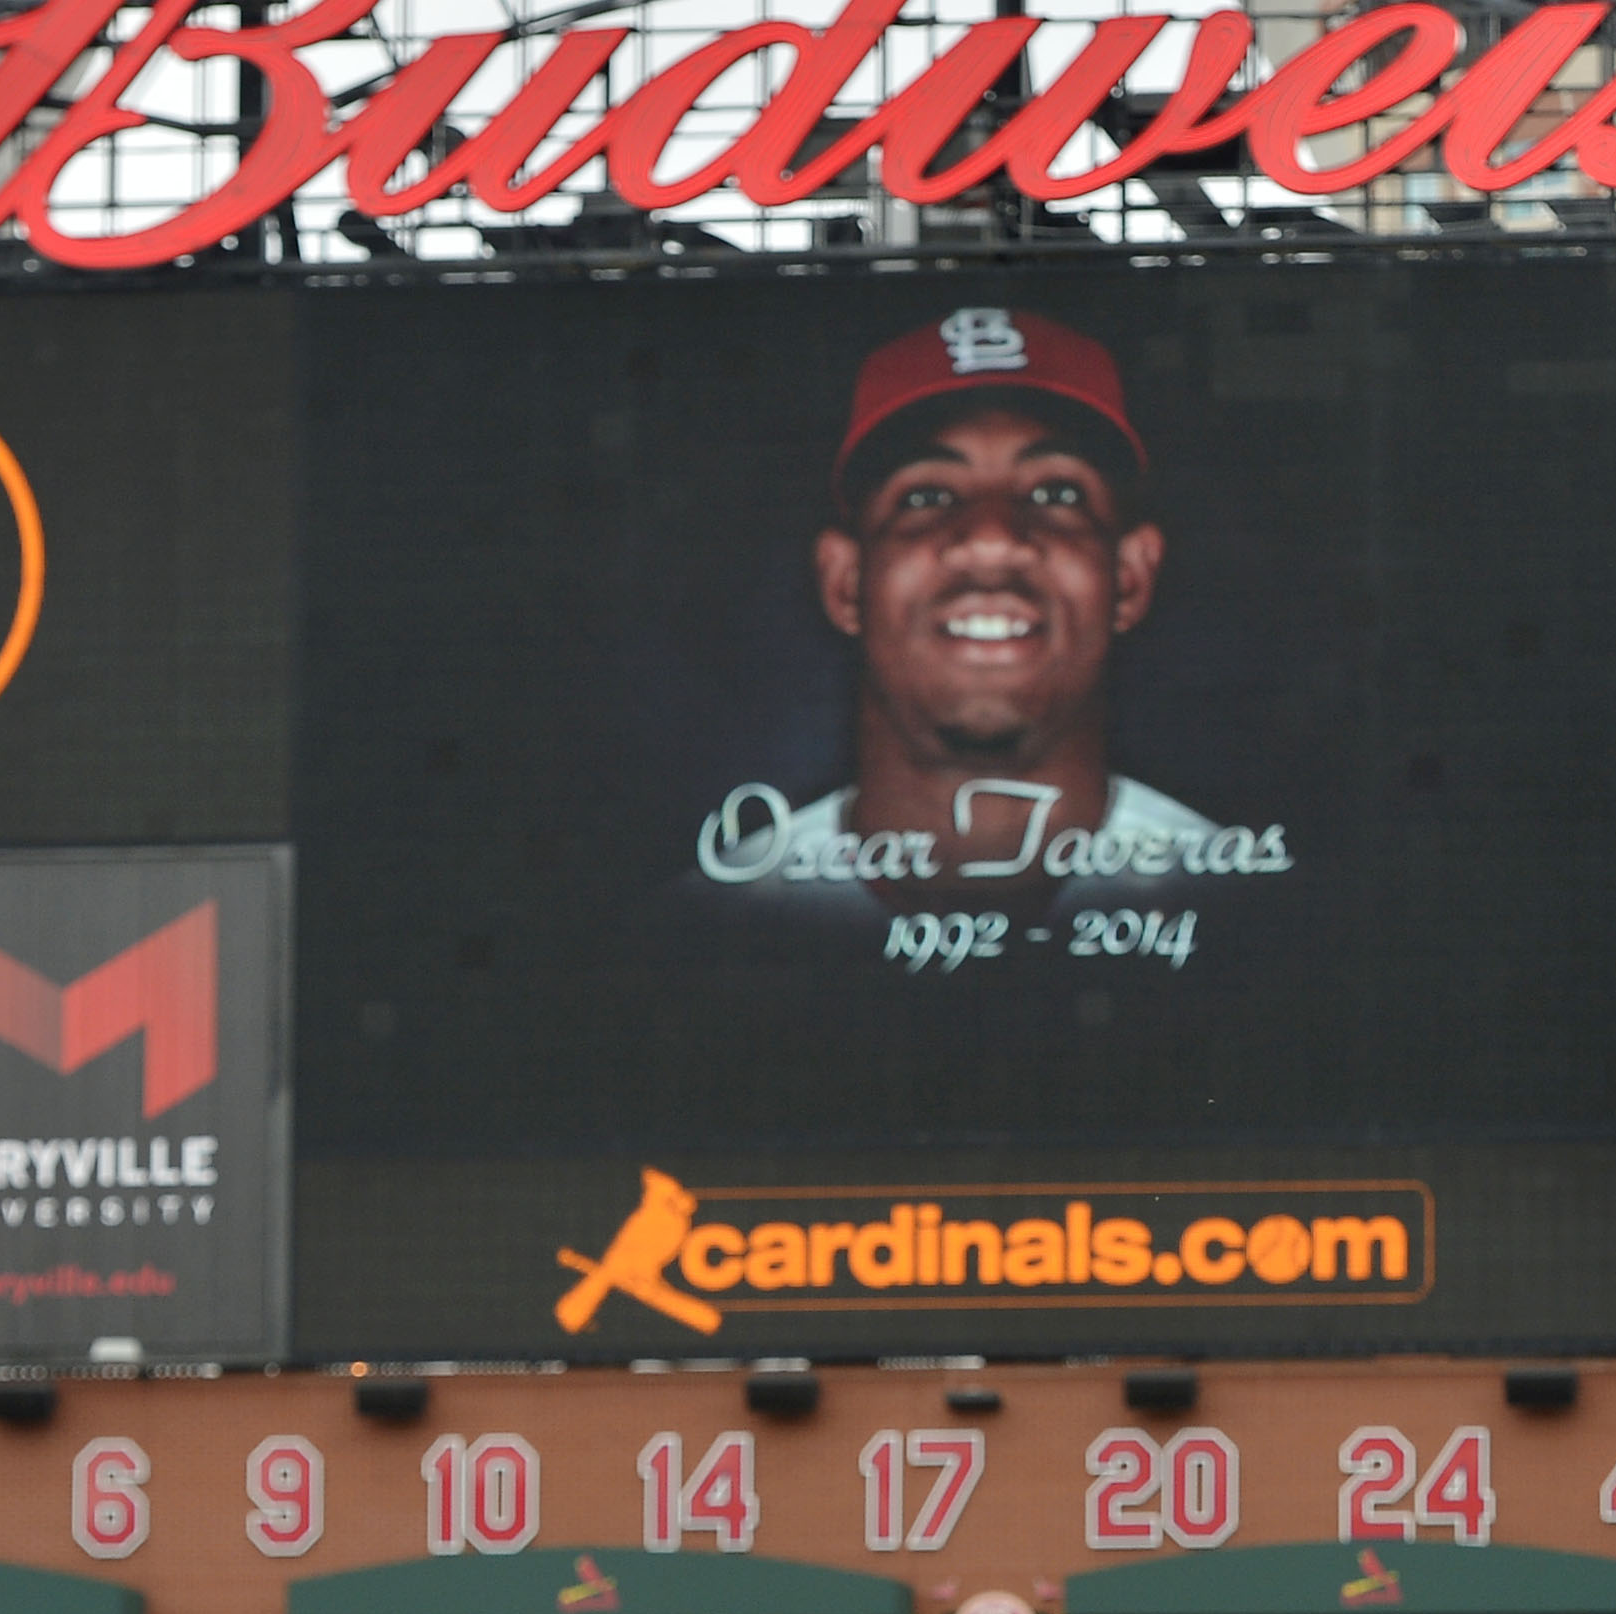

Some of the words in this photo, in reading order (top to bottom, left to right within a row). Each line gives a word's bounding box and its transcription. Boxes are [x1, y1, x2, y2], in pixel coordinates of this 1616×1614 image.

[696, 781, 940, 883] Oscar
[954, 778, 1295, 878] Taveras
[884, 911, 1008, 973] 1992
[1069, 909, 1199, 970] 2014
[681, 1202, 1408, 1290] cardinals.com
[72, 1436, 150, 1559] 6
[246, 1435, 324, 1557] 9
[421, 1433, 540, 1555] 10
[637, 1431, 759, 1553] 14
[859, 1429, 985, 1551] 17
[1086, 1428, 1240, 1549] 20
[1339, 1426, 1496, 1546] 24
